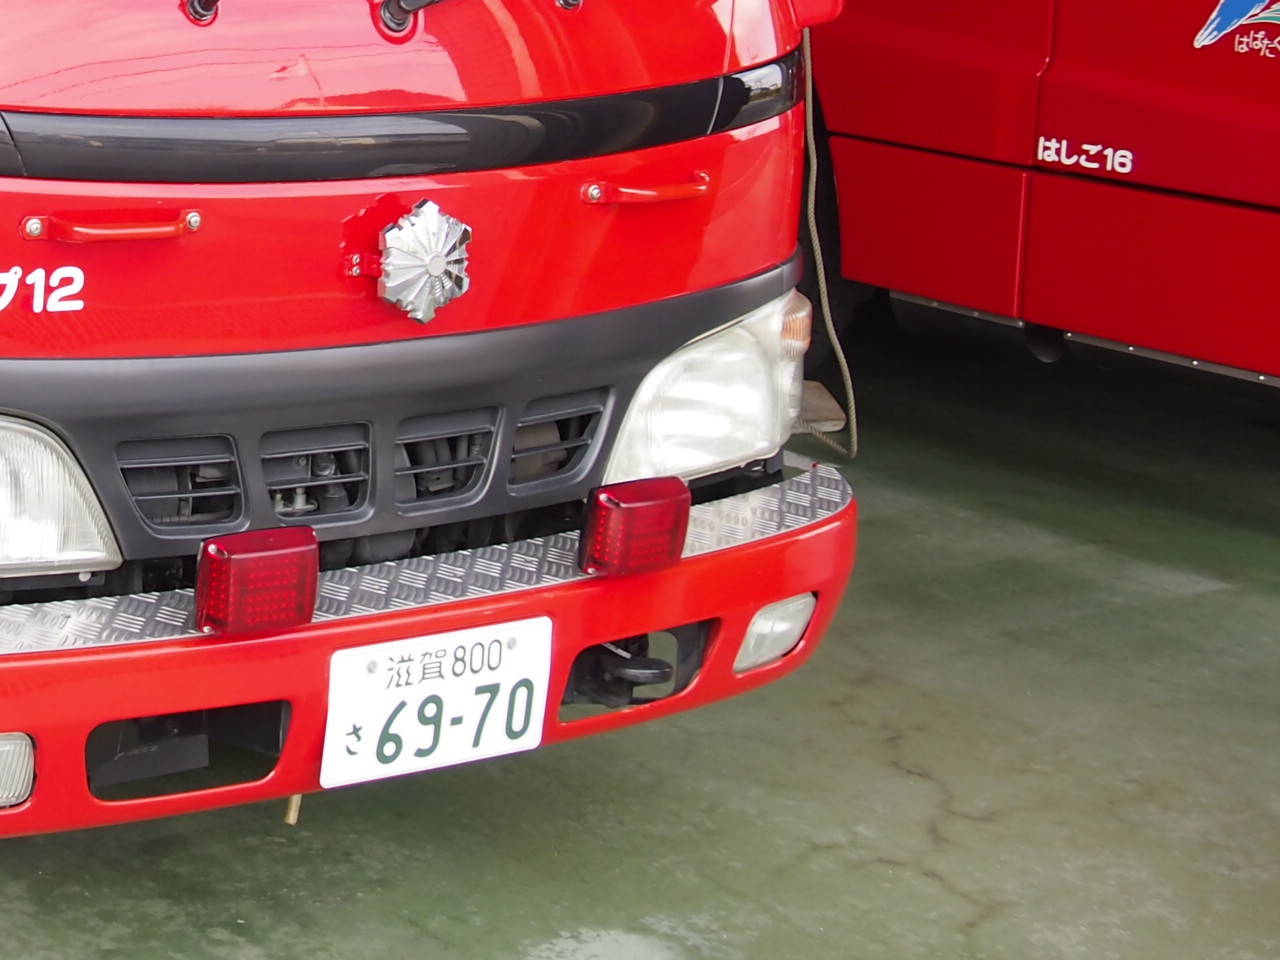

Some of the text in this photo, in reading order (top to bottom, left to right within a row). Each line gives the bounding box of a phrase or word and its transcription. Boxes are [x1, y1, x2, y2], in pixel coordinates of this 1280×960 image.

[1037, 136, 1134, 174] はしご16
[386, 639, 503, 690] 滋賀800
[345, 677, 535, 765] さ 69-70
